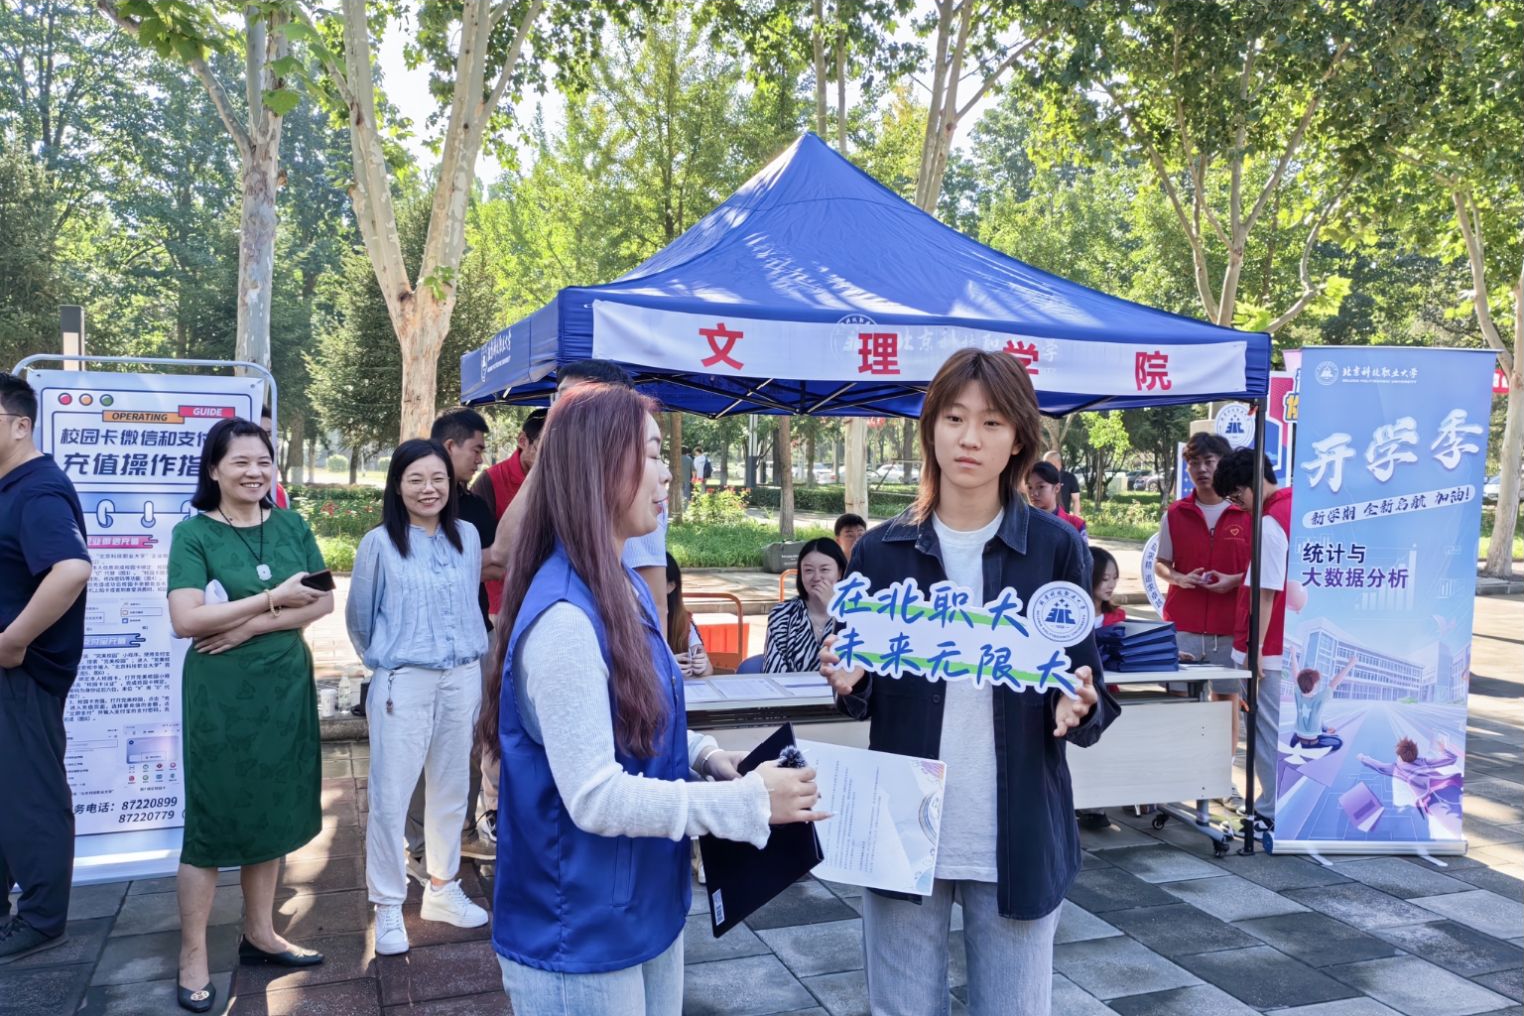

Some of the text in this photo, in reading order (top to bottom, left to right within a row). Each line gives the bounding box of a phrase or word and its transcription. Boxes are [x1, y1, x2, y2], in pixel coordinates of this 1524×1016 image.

[112, 412, 168, 422] OPERATING
[192, 407, 223, 417] GUIDE
[1301, 409, 1484, 492] 开学季
[1311, 509, 1356, 525] 新学期
[1363, 495, 1426, 517] 全新启航
[1303, 543, 1366, 564] 统计与
[1302, 567, 1409, 589] 大数据分析
[831, 577, 1030, 638] 在北职大
[833, 626, 1079, 695] 未来无限大
[121, 796, 178, 811] 87220899
[118, 810, 175, 823] 87220779
